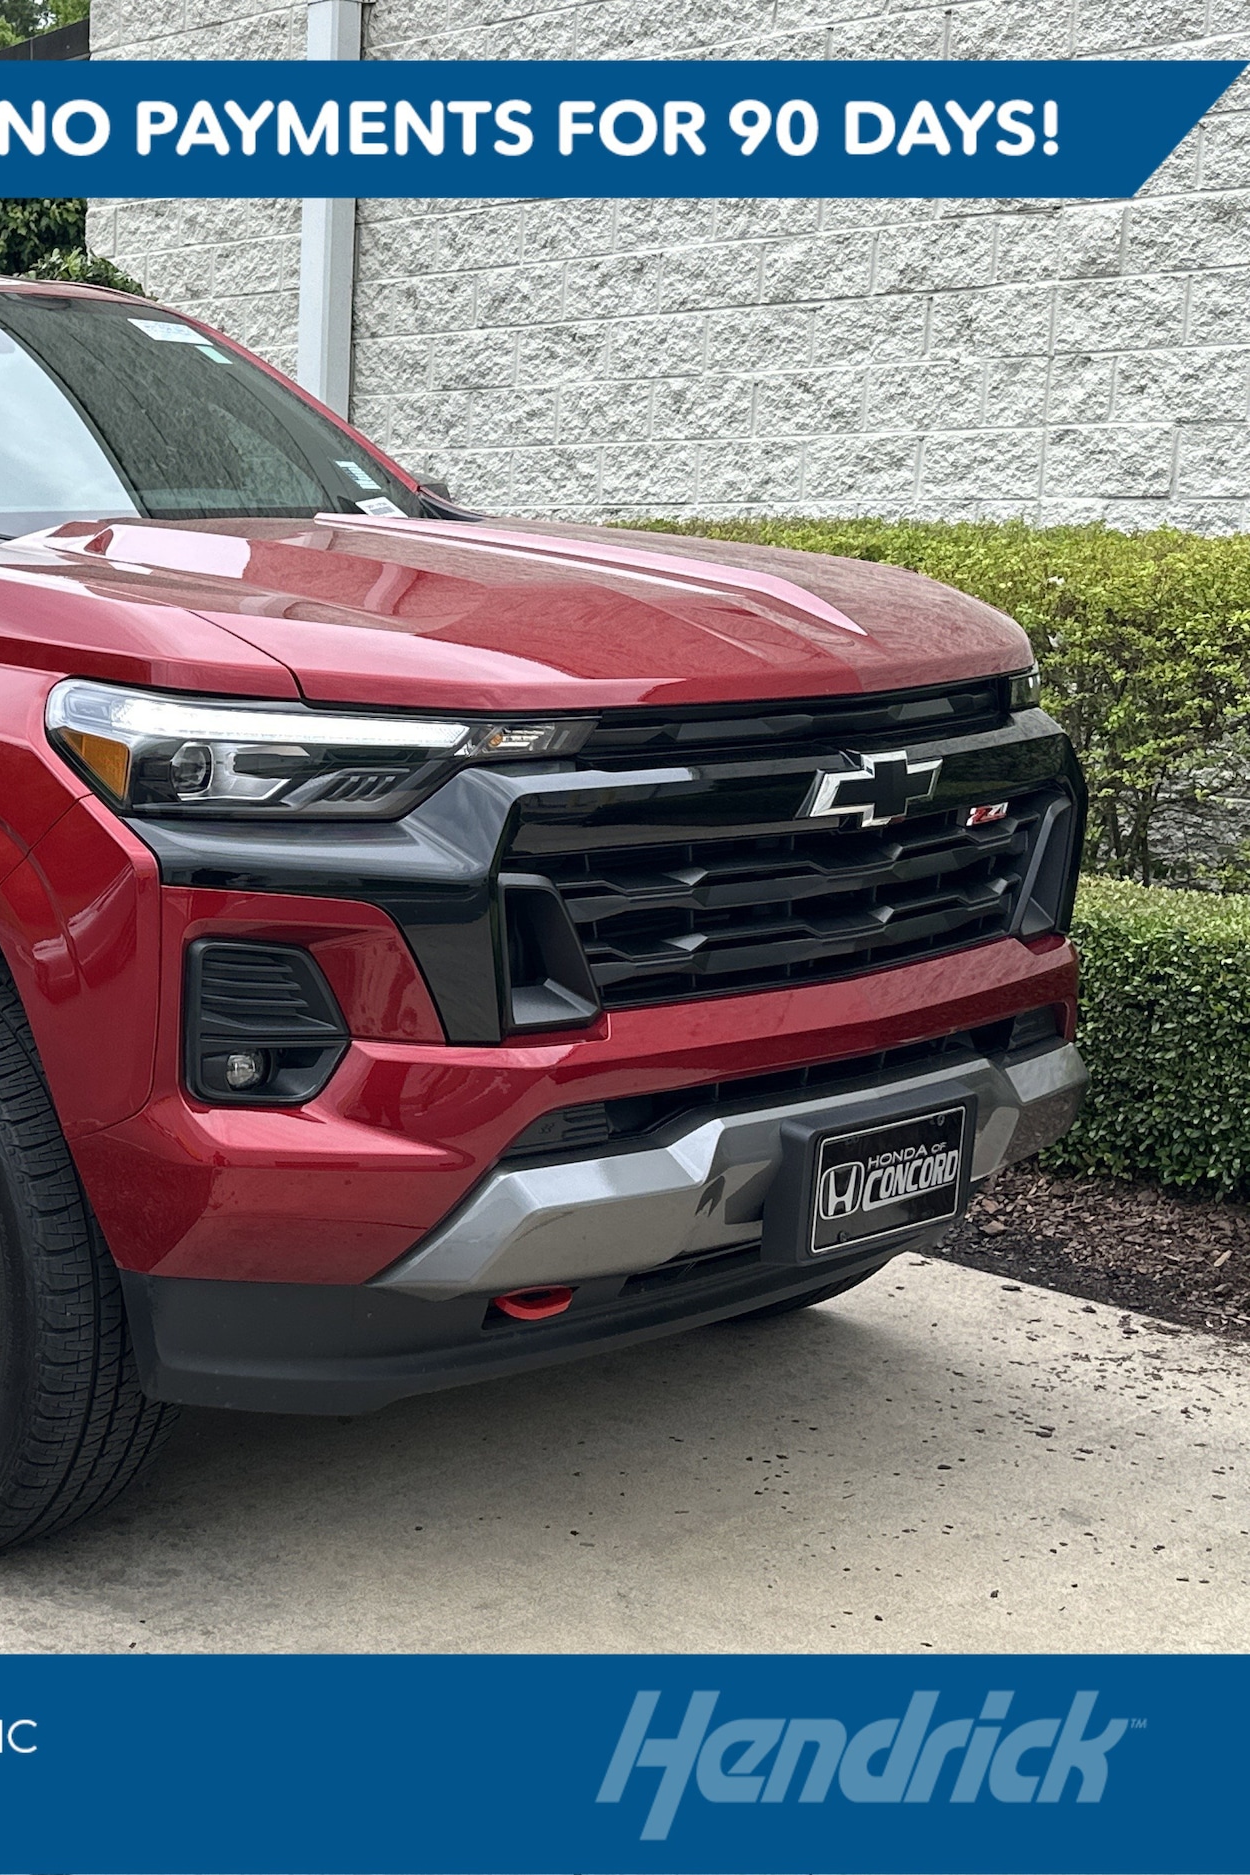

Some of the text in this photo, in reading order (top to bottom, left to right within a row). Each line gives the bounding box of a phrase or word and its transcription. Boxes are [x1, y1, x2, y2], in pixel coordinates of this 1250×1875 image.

[867, 1142, 947, 1171] HONDA OF
[862, 1150, 959, 1212] CONCORD
